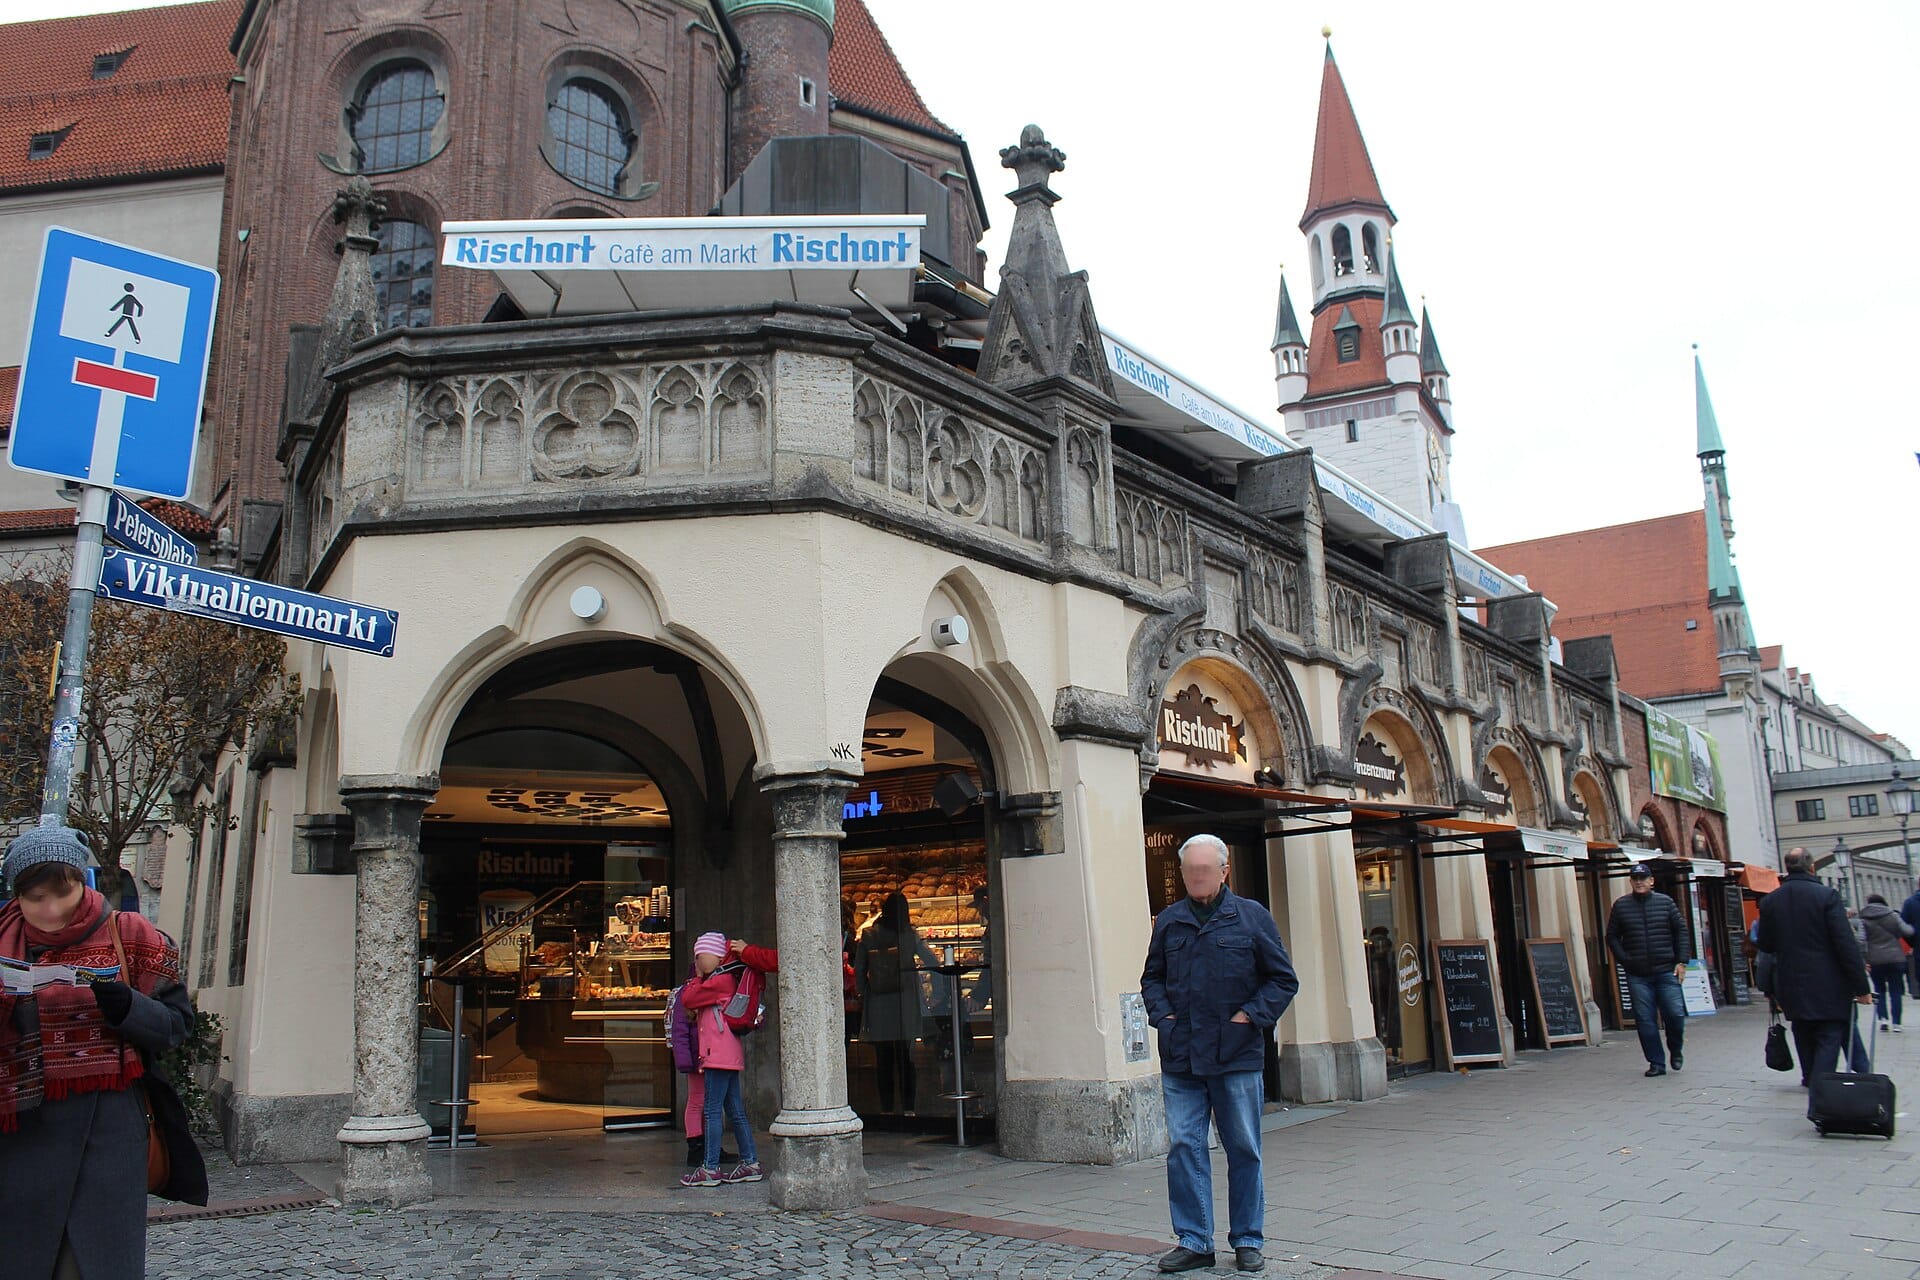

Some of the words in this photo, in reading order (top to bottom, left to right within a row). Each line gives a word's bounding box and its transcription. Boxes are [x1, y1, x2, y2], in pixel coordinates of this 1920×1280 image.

[456, 234, 597, 264] Rischart
[661, 248, 692, 264] am
[700, 243, 758, 264] Markt
[773, 231, 912, 263] Rischart
[1113, 345, 1171, 399] Rischart
[112, 497, 193, 565] Petersplatz
[123, 557, 378, 643] Viktualienmarkt
[1164, 708, 1231, 753] Rischart
[829, 742, 855, 760] WK
[842, 791, 884, 820] art
[478, 851, 574, 875] Rischart
